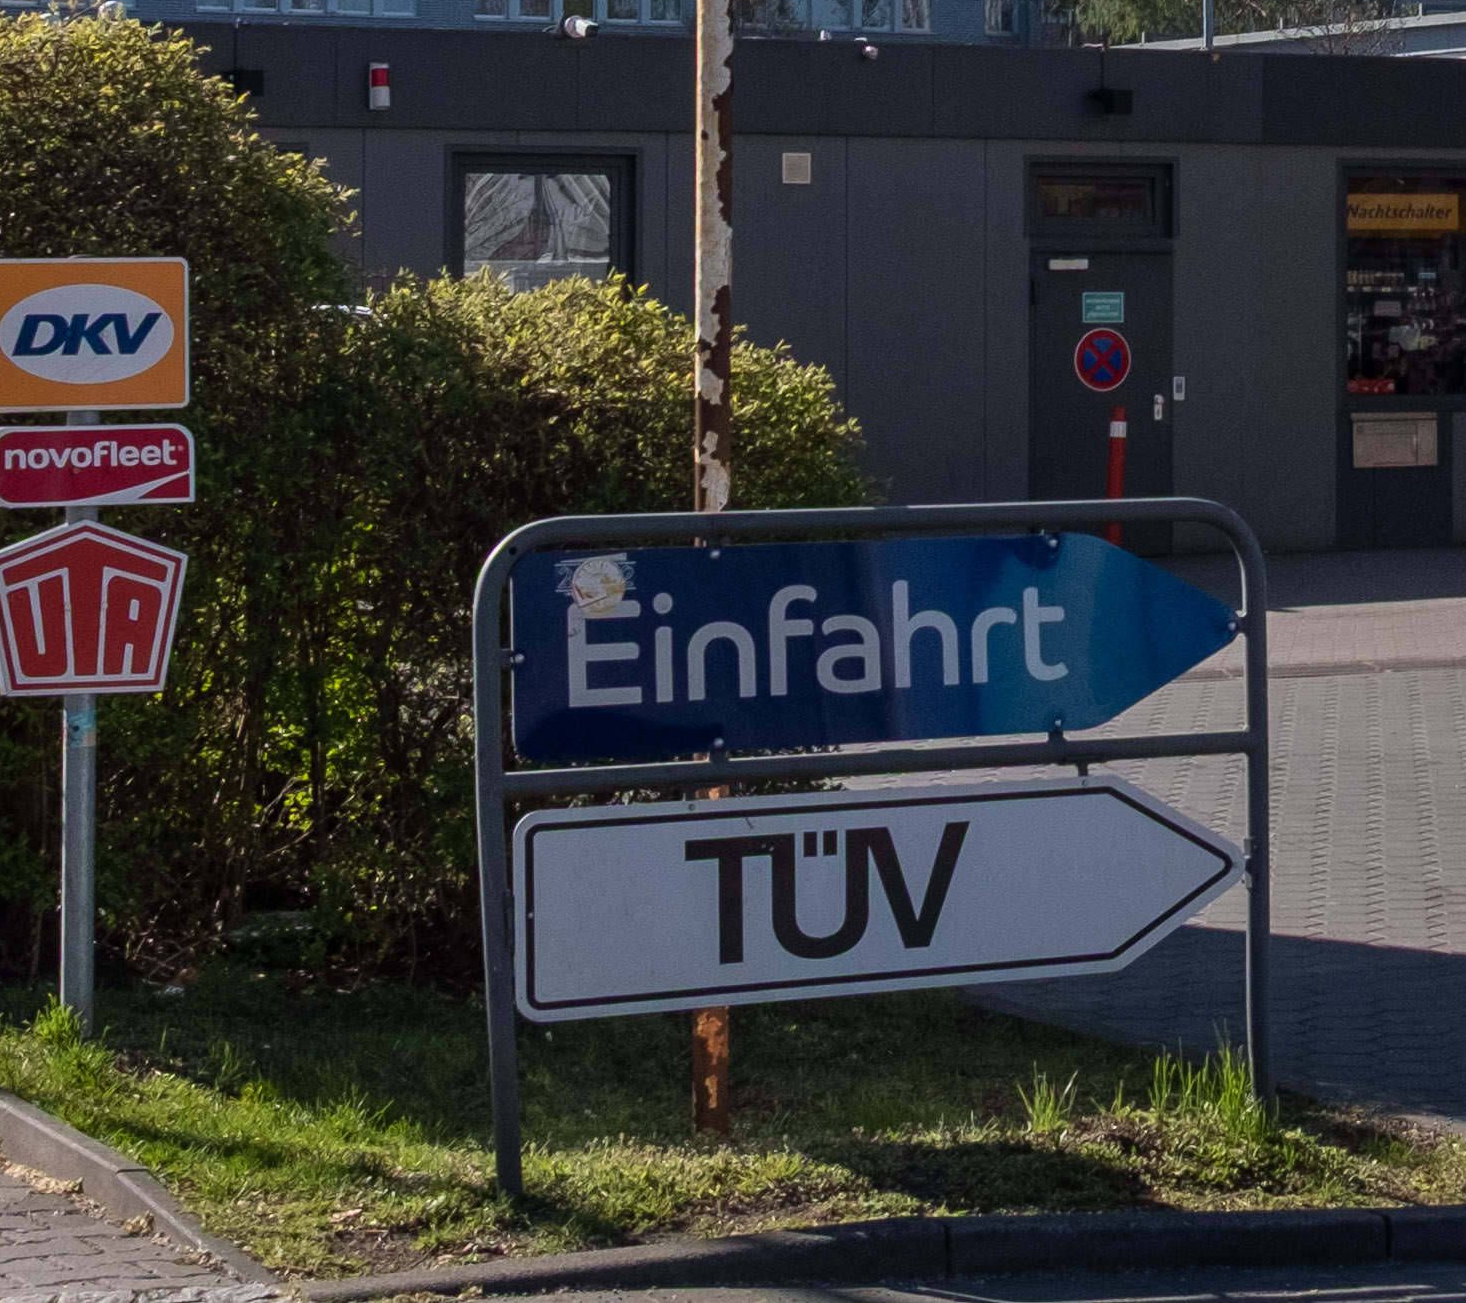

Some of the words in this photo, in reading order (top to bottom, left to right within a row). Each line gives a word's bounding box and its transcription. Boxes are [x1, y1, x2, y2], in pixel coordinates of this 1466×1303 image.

[1347, 203, 1452, 219] Nachtschalter
[11, 311, 163, 358] DKV
[4, 439, 178, 470] novofleet
[1, 534, 169, 677] UTA
[567, 579, 1069, 709] Einfahrt
[684, 821, 970, 965] TÜV
